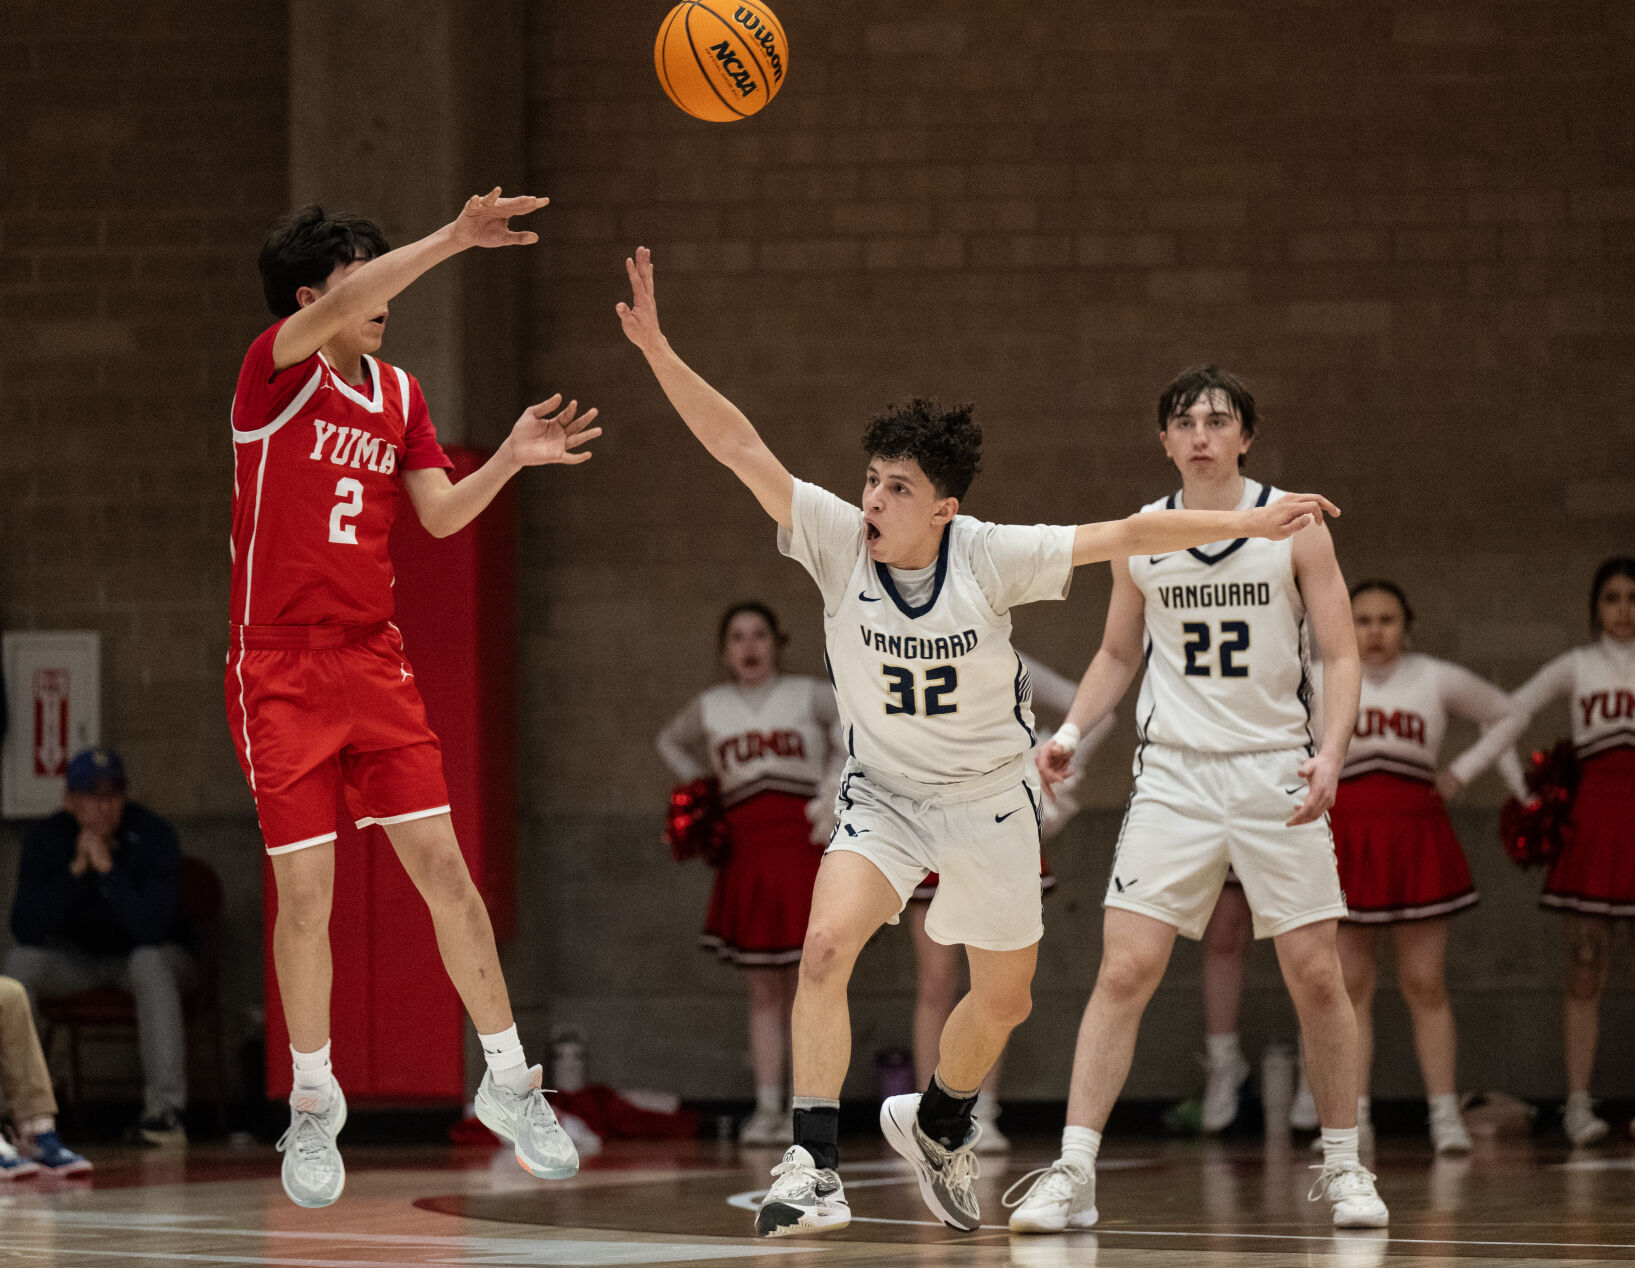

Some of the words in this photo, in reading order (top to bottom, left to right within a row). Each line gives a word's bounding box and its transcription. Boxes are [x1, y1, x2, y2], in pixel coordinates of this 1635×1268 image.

[711, 40, 757, 97] NCAA
[733, 6, 783, 82] Wilson
[310, 419, 397, 475] YUMA
[328, 477, 364, 544] 2
[1158, 582, 1270, 609] VANGUARD
[860, 624, 978, 660] VANGUARD
[1182, 620, 1250, 679] 22
[881, 663, 960, 719] 32
[717, 730, 806, 771] YUMA
[1353, 707, 1425, 745] UMA
